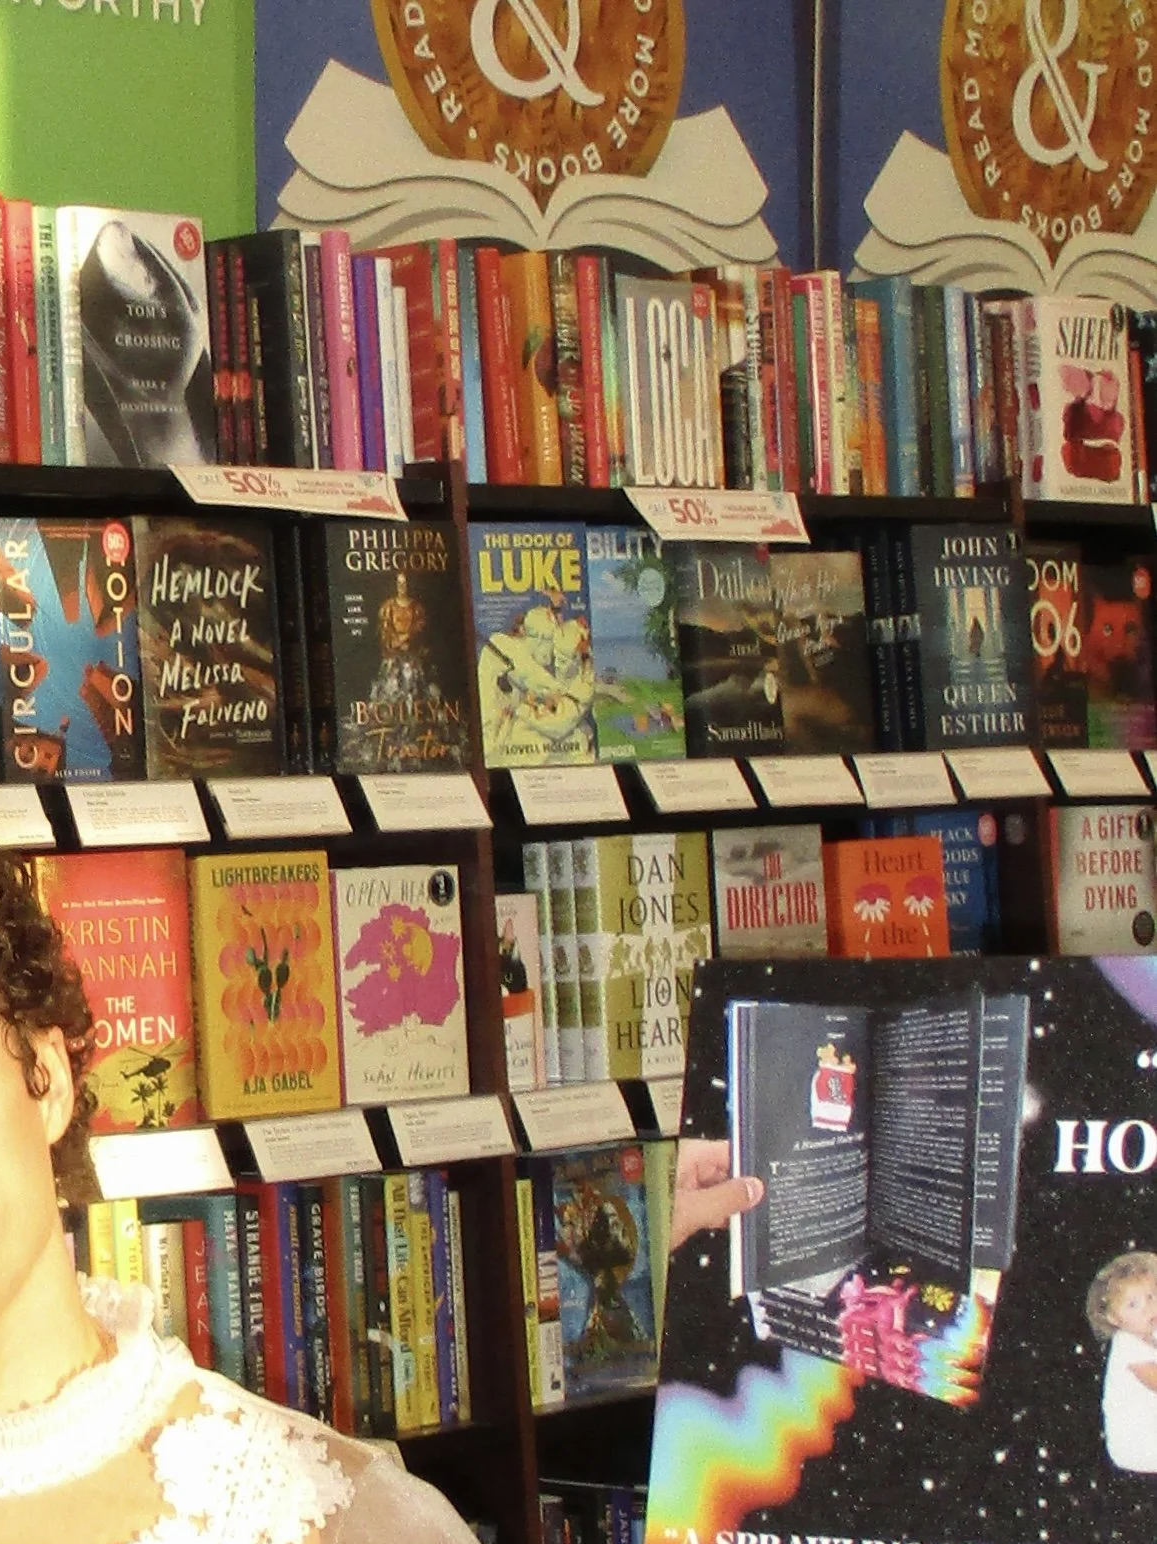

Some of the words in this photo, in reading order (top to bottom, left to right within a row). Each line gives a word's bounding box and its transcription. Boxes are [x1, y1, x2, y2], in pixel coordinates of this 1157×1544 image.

[115, 333, 183, 351] CROSSING
[1055, 315, 1122, 361] SHEER
[348, 528, 447, 550] PHILIPPA
[483, 533, 510, 548] THE
[512, 533, 555, 548] BOOK
[557, 532, 572, 547] OF
[942, 535, 998, 558] JOHN
[345, 550, 448, 572] GREGORY
[477, 549, 582, 594] LUKE
[933, 567, 1010, 588] IRVING
[170, 623, 182, 643] A
[191, 617, 250, 647] NOVEL
[6, 538, 39, 771] CIRCULAR
[943, 683, 1018, 706] QUEEN
[942, 711, 1025, 736] ESTHER
[1081, 814, 1095, 840] A
[1097, 813, 1137, 840] GIFT
[211, 863, 321, 888] LIGHTBREAKERS
[627, 852, 686, 886] DAN
[862, 849, 926, 877] Heart
[1076, 852, 1142, 875] BEFORE
[726, 879, 820, 930] DIRECTOR
[1084, 885, 1138, 910] DYING
[619, 893, 700, 934] JONES
[60, 915, 170, 945] KRISTIN
[880, 924, 919, 947] the
[106, 996, 136, 1014] THE
[94, 1015, 176, 1049] OMEN
[1053, 1119, 1157, 1174] HO
[393, 1183, 405, 1203] All
[393, 1207, 407, 1240] That
[245, 1209, 263, 1286] STRANGE
[395, 1243, 409, 1272] Life
[195, 1240, 209, 1335] JEAN
[396, 1276, 410, 1304] Can
[249, 1292, 264, 1336] FOLK
[398, 1306, 412, 1353] Afford
